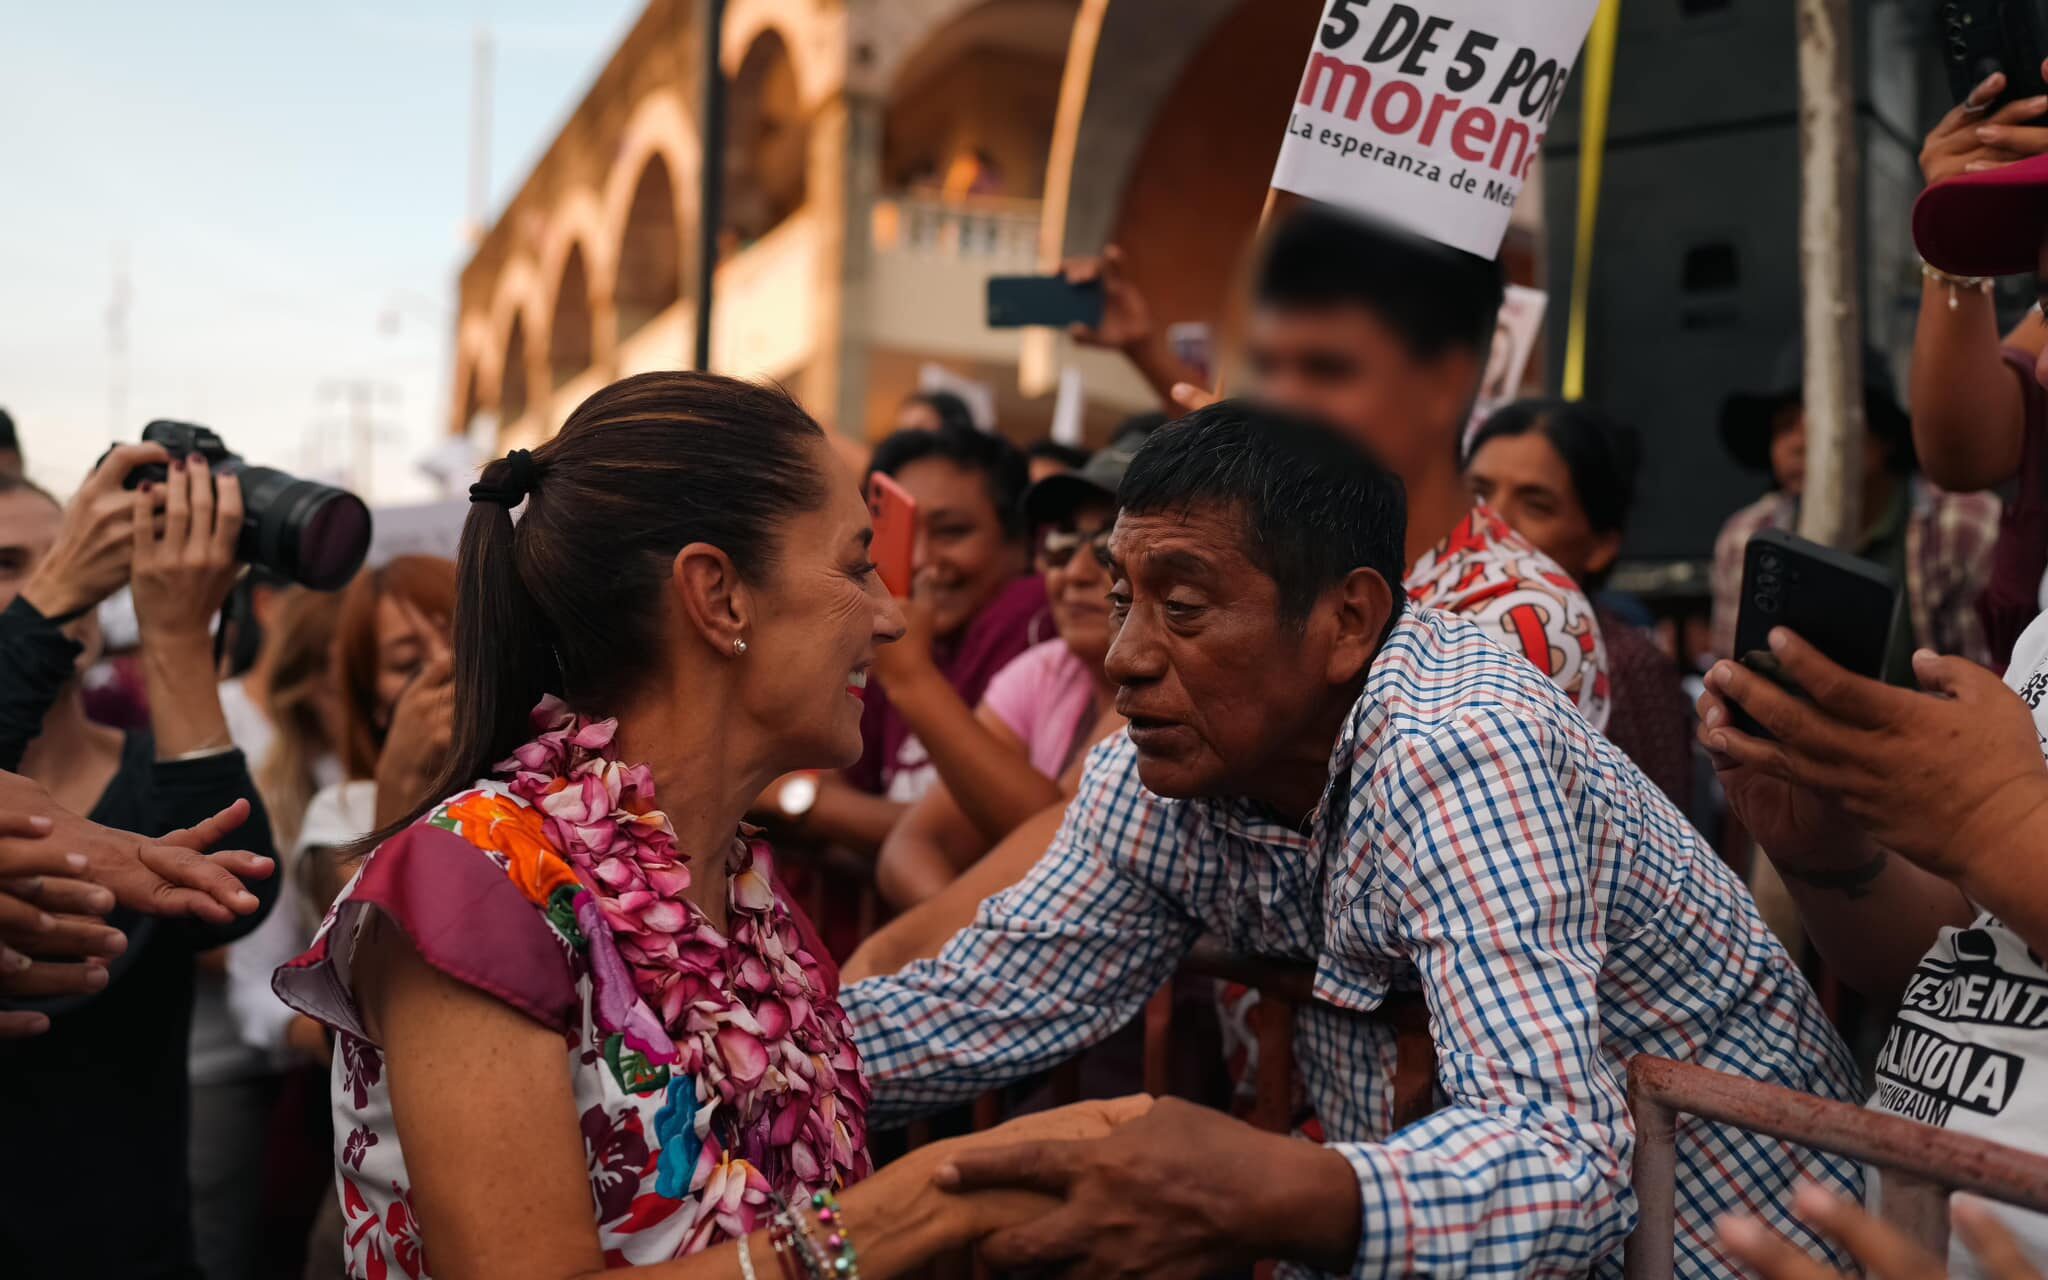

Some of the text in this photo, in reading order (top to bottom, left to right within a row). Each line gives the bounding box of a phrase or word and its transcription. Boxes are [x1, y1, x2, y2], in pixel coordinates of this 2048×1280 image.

[1320, 0, 1369, 50] 5
[1362, 3, 1454, 77] DE
[1445, 29, 1499, 93] 5
[1289, 113, 1313, 140] La
[1319, 127, 1442, 182] esperanza
[1449, 168, 1477, 194] de
